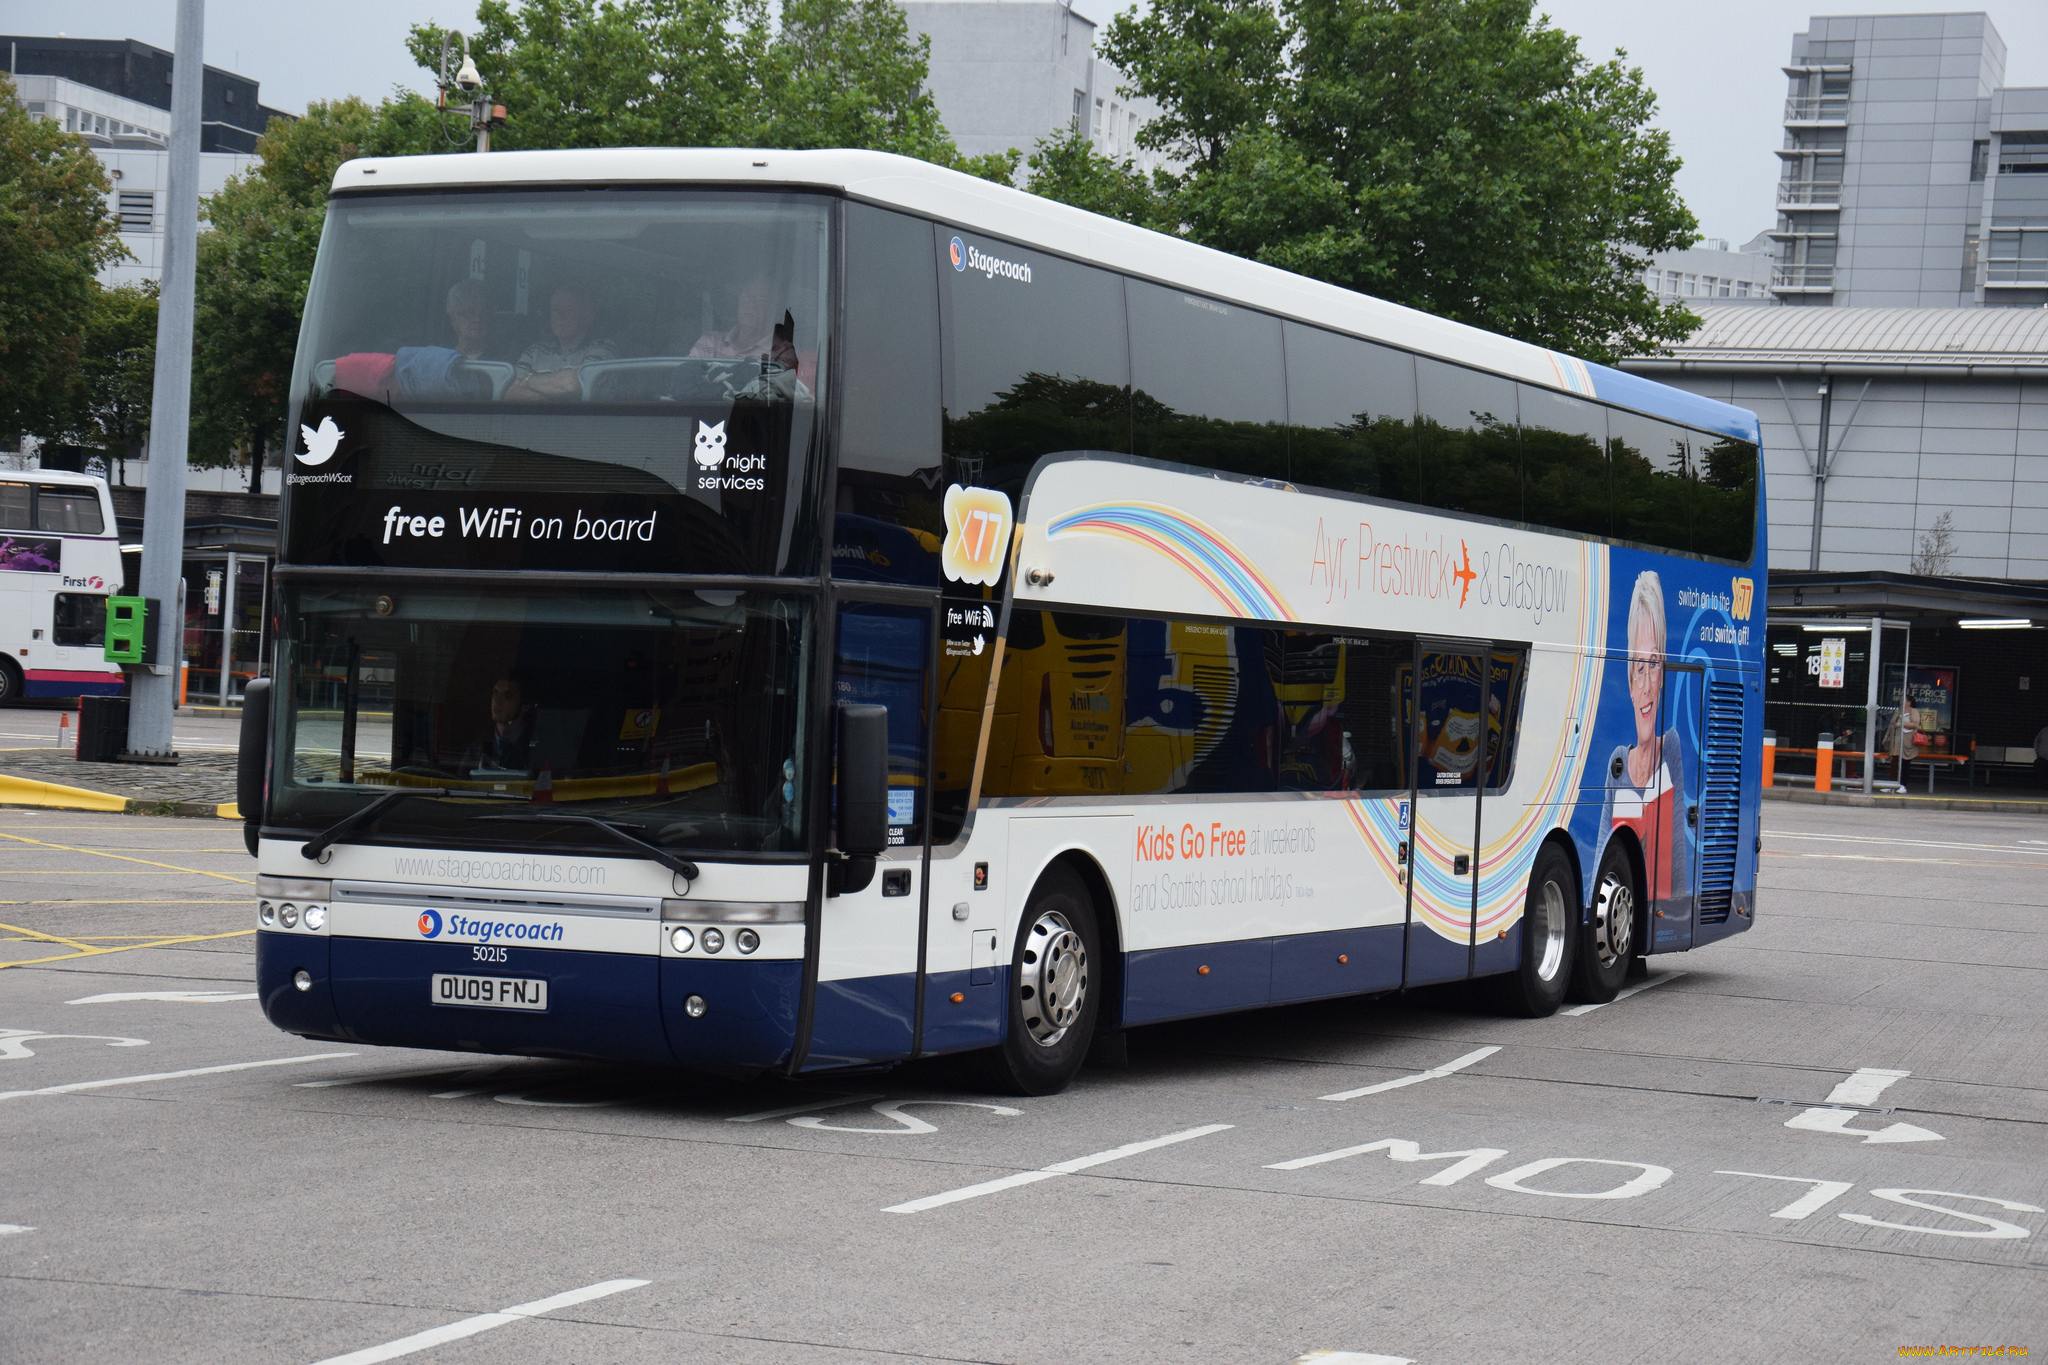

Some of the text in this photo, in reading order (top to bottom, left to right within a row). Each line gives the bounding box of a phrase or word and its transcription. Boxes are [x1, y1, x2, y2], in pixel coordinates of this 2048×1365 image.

[968, 245, 1031, 283] Stagecoach
[726, 454, 766, 473] night
[286, 472, 352, 486] @StagecoachWScot
[698, 474, 764, 491] services
[382, 506, 657, 544] free WiFi on board
[953, 507, 1003, 563] X77
[63, 575, 87, 587] First
[1310, 517, 1568, 625] Ayr, Prestwick & Glasgow
[1679, 587, 1700, 608] switch
[1711, 592, 1719, 611] to
[1720, 592, 1730, 612] the
[1732, 577, 1753, 620] X77
[947, 608, 981, 627] free WiFi
[1701, 623, 1714, 642] and
[1715, 624, 1737, 645] switch
[1806, 655, 1821, 675] 18
[1919, 689, 1947, 698] PRICE
[889, 828, 904, 836] CLEAR
[891, 836, 905, 844] DOOR
[1136, 819, 1316, 862] Kids Go Free at weekends
[394, 855, 606, 884] www.stagecoachbus.com
[1133, 867, 1293, 912] and Scottish school holidays
[447, 914, 564, 943] Stagecoach
[472, 946, 508, 963] 50215
[500, 980, 540, 1004] FNJ
[1262, 1137, 2046, 1240] SLOW
